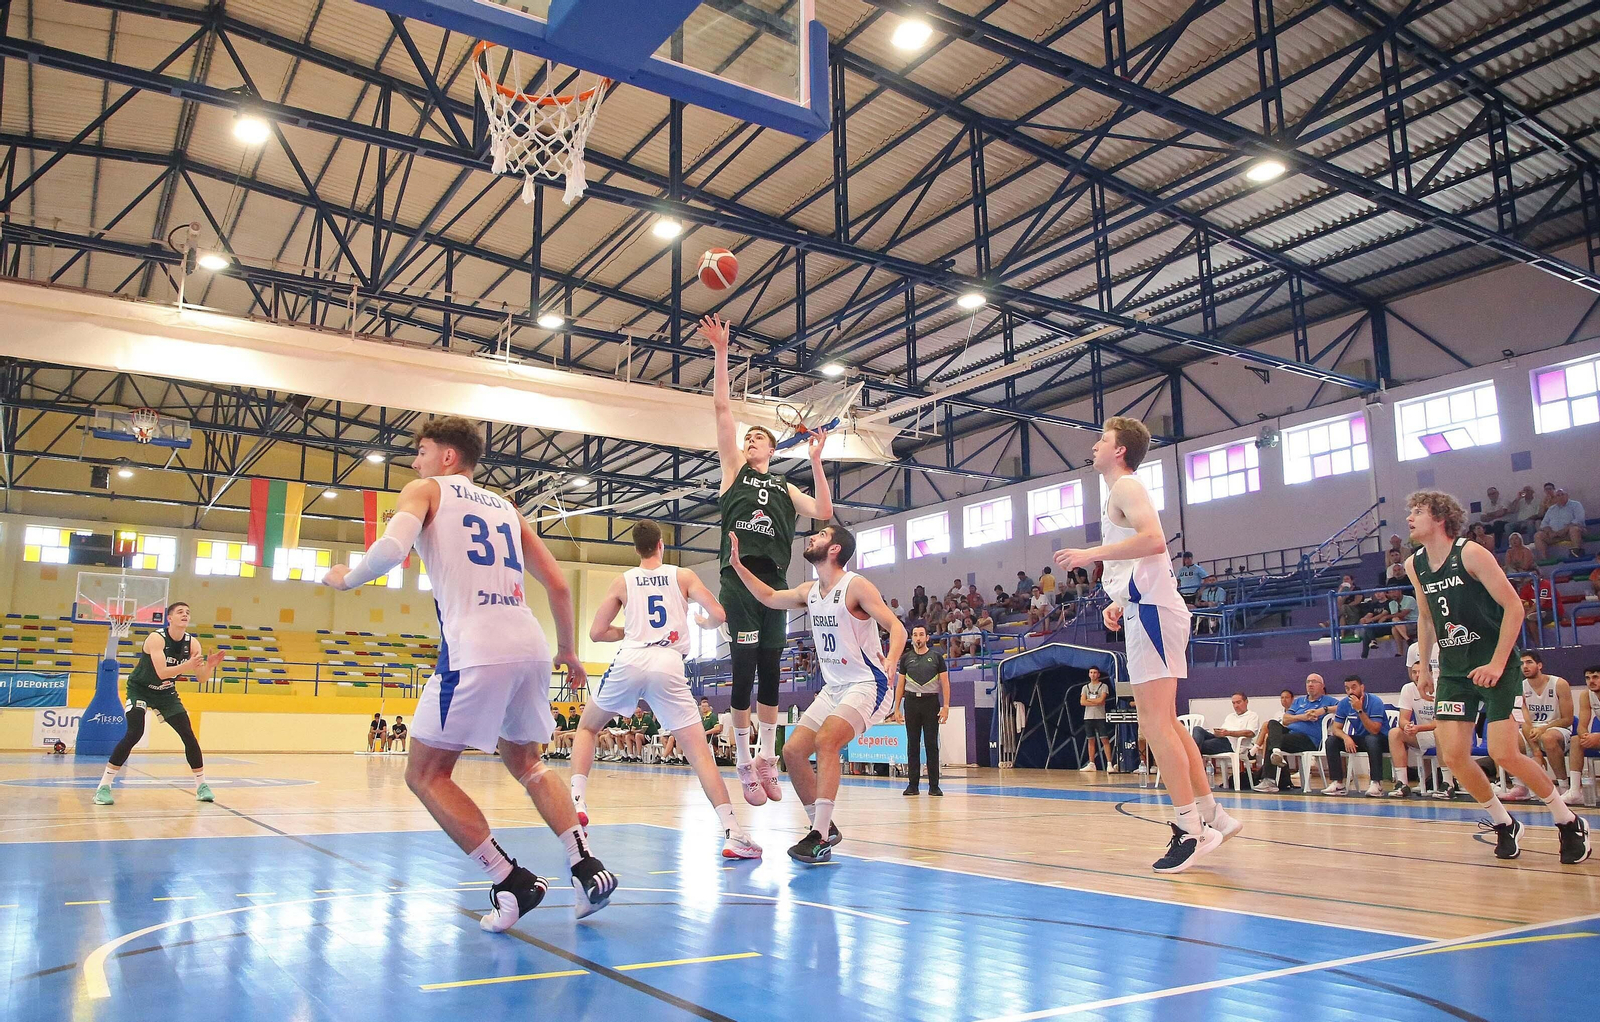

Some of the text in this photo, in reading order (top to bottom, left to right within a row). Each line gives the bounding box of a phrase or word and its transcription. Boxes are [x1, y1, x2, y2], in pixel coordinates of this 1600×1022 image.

[757, 488, 769, 505] 9
[735, 520, 775, 537] BIOVELA
[463, 514, 522, 573] 31
[635, 575, 669, 586] LEVIN
[647, 595, 667, 628] 5
[1438, 596, 1450, 616] 3
[813, 615, 838, 627] ISRAEL
[822, 633, 836, 652] 20
[1438, 631, 1481, 648] BIOVELA
[16, 680, 65, 688] DEPORTES
[1529, 703, 1554, 712] ISRAEL
[1533, 713, 1548, 721] 10
[858, 734, 898, 748] deportes
